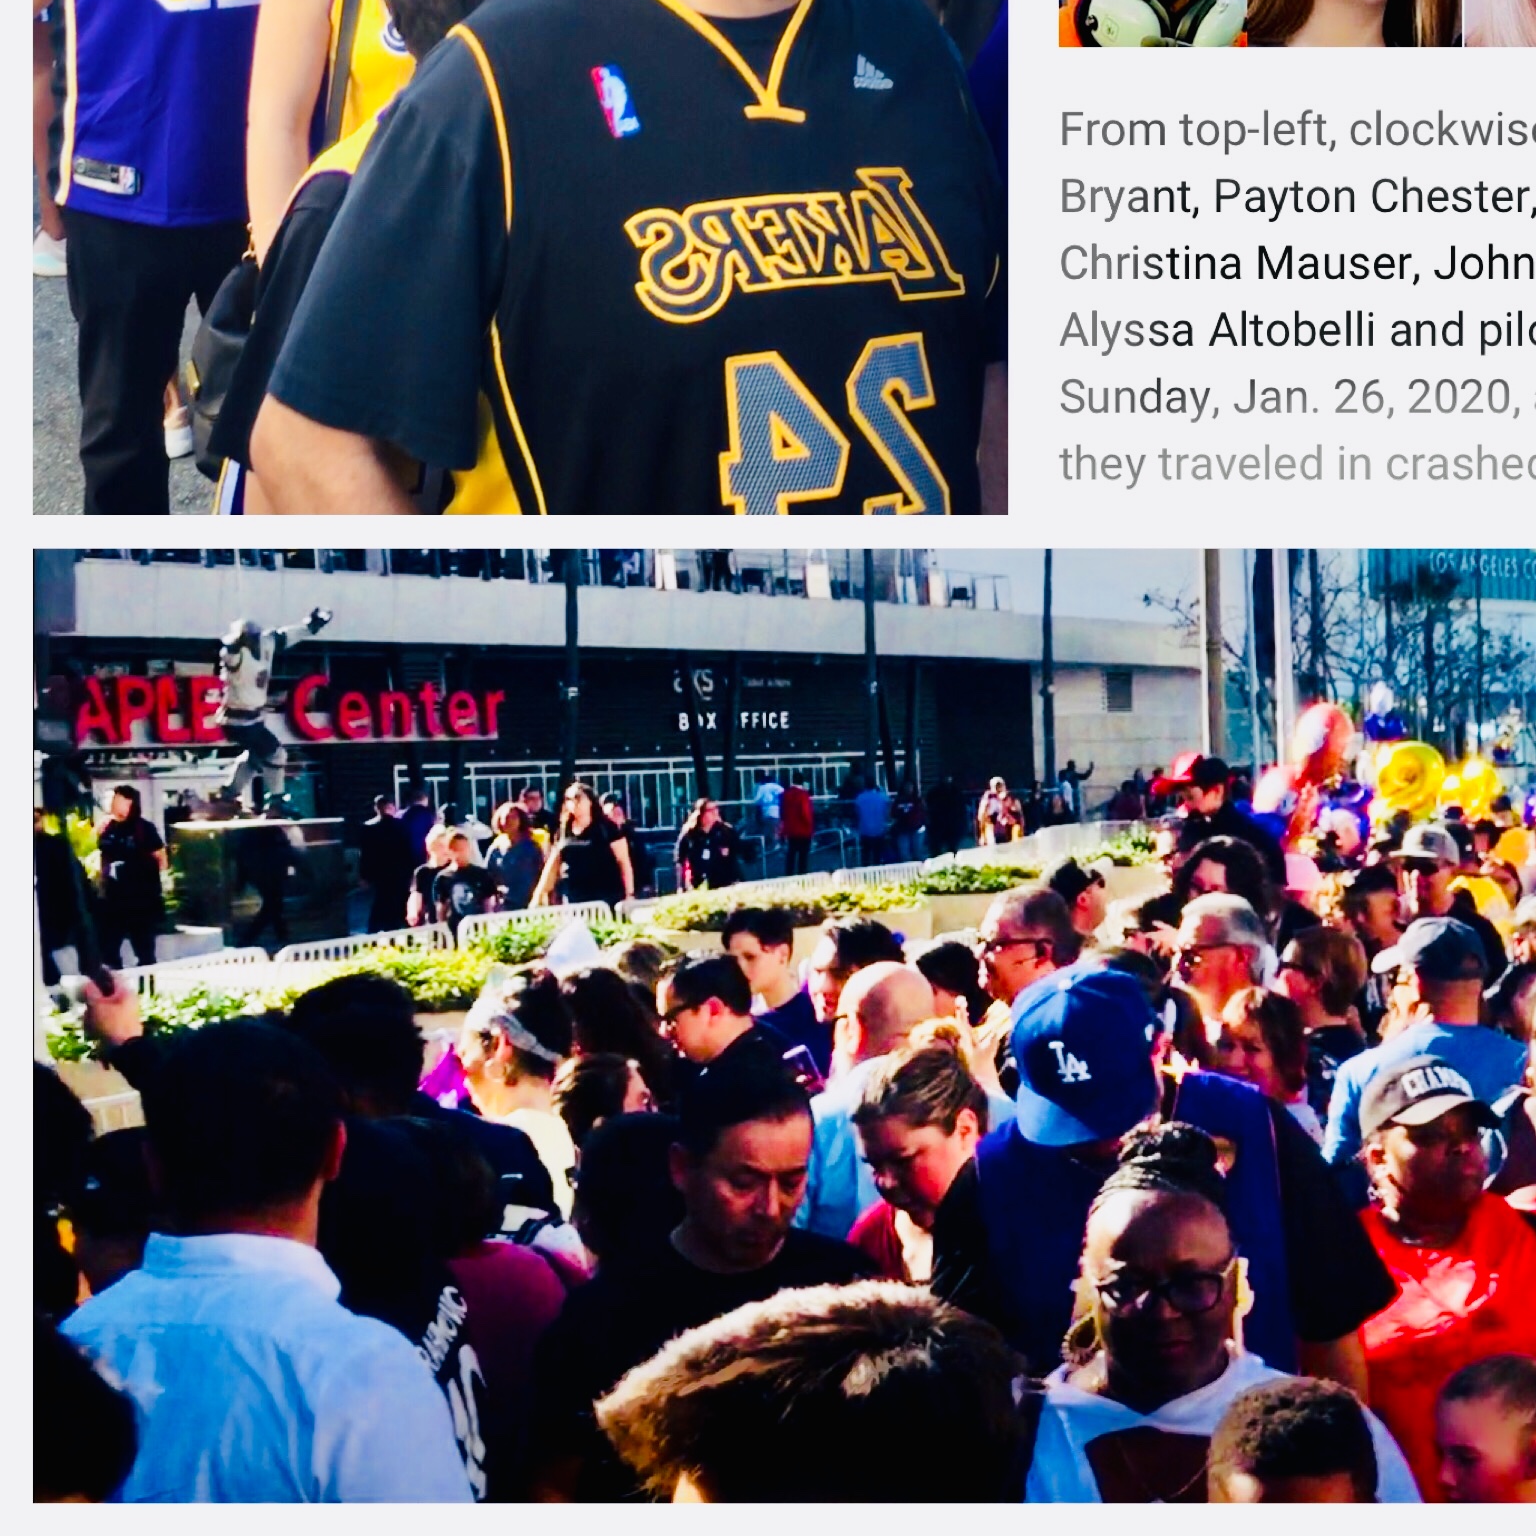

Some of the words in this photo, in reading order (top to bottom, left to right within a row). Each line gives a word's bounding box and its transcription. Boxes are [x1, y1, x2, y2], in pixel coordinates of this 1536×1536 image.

[77, 674, 225, 745] APLE
[290, 672, 505, 741] Center
[1048, 1040, 1091, 1083] LA
